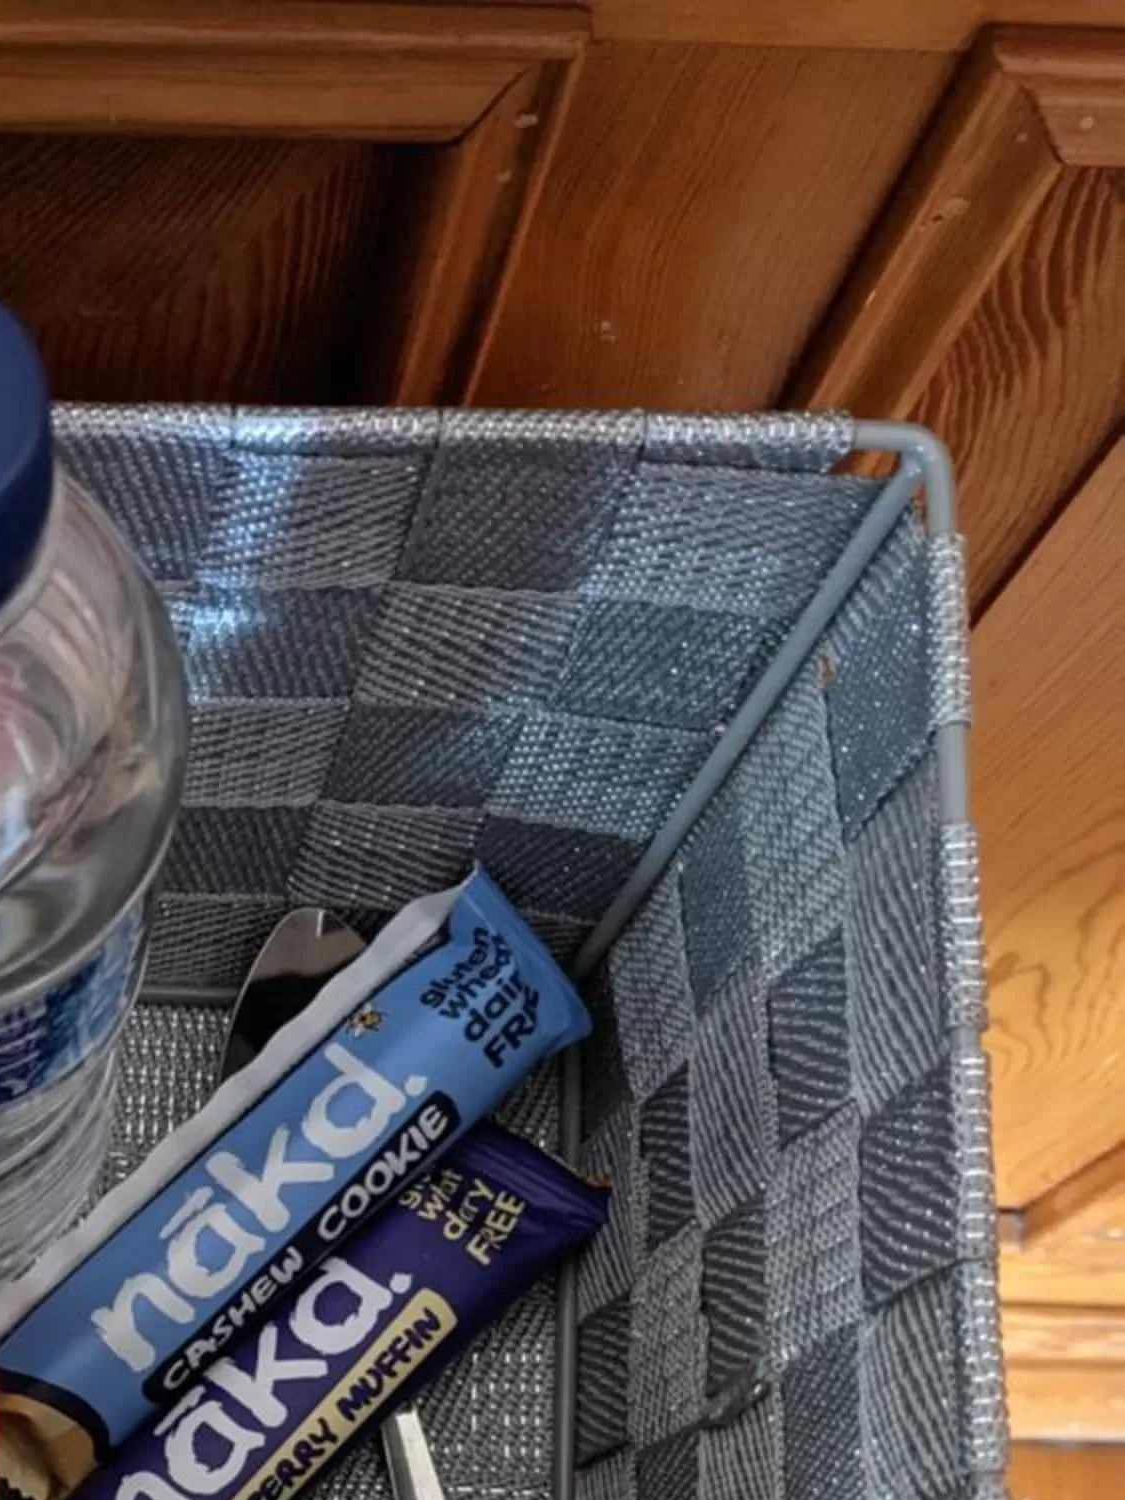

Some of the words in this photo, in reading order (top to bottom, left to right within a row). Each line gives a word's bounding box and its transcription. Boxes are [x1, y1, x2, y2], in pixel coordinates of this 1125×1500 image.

[163, 1246, 305, 1390] CASHEW
[318, 1104, 448, 1241] COOKIE
[335, 1306, 442, 1422] MUFFIN
